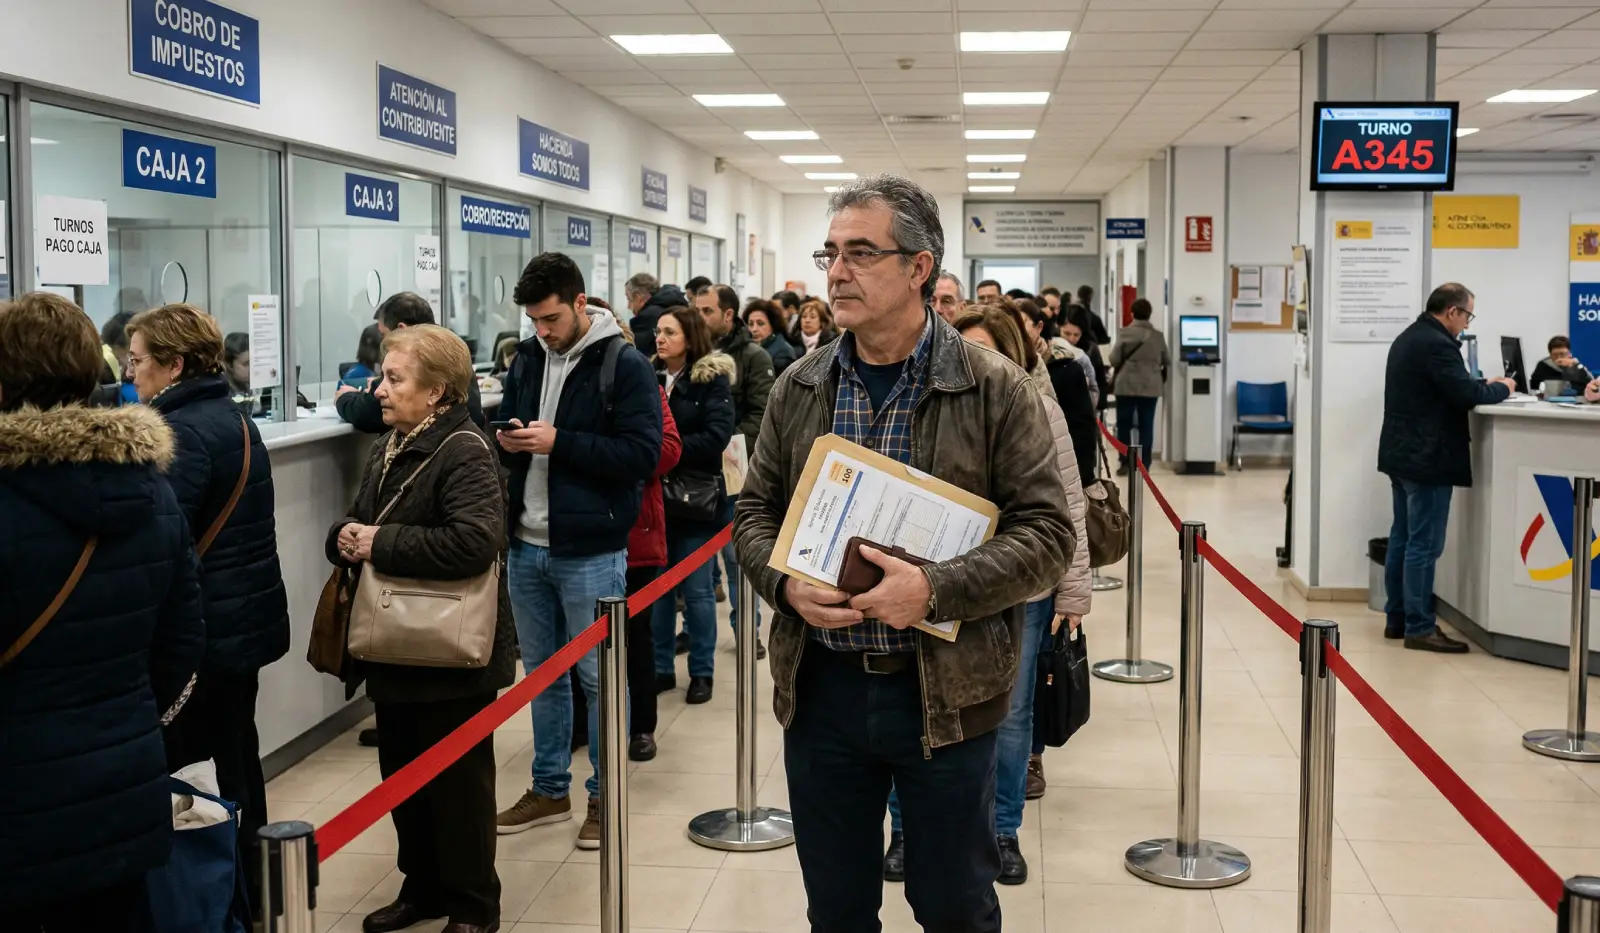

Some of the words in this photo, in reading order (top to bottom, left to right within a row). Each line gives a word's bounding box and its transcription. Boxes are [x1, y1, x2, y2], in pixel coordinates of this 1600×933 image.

[155, 0, 216, 42] COBRO
[220, 21, 241, 51] DE
[151, 35, 245, 87] IMPUESTOS
[390, 81, 435, 114] ATENCIÓN
[436, 97, 448, 118] AL
[382, 106, 455, 145] CONTRIBUYENTE
[1358, 122, 1412, 136] TURNO
[539, 132, 574, 159] HACIENDA
[1331, 139, 1434, 171] A345
[136, 146, 191, 183] CAJA
[195, 156, 206, 185] 2
[531, 152, 558, 176] SOMOS
[558, 161, 580, 182] TODOS
[353, 183, 385, 211] CAJA
[386, 190, 394, 213] 3
[54, 217, 94, 234] TURNOS
[462, 203, 530, 232] COBRO/RECEPCIÓN
[570, 221, 585, 241] CAJA
[46, 237, 75, 253] PAGO
[77, 240, 102, 255] CAJA
[1579, 293, 1600, 306] HA
[1578, 309, 1600, 321] SO
[841, 467, 853, 484] 100
